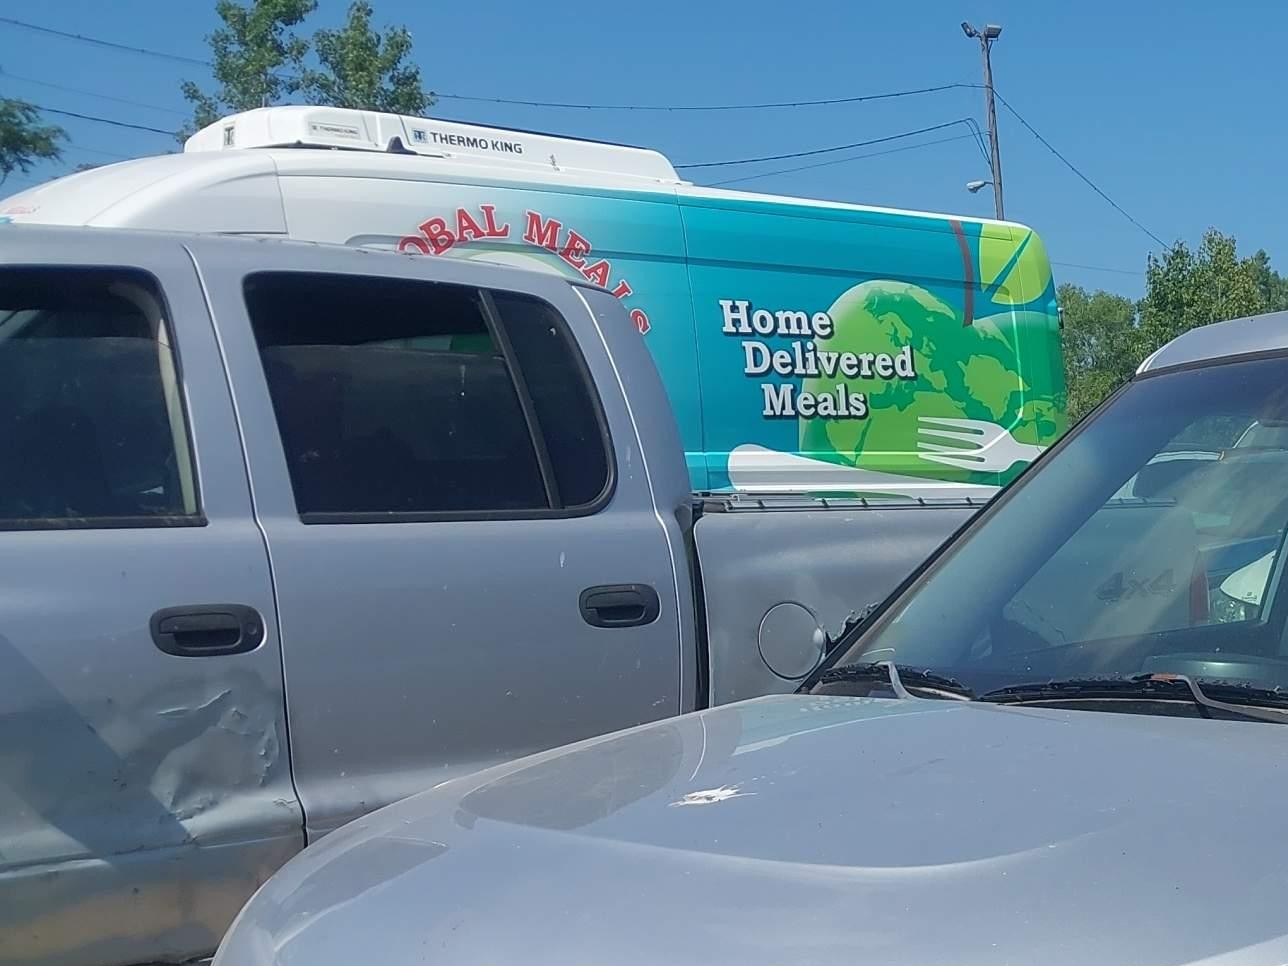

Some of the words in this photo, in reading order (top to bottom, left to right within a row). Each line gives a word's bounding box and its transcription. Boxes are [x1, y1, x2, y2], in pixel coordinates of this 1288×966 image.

[430, 131, 489, 150] THERMO
[491, 139, 522, 154] KING
[718, 299, 833, 337] Home
[741, 340, 916, 378] Delivered
[760, 383, 868, 418] Meals
